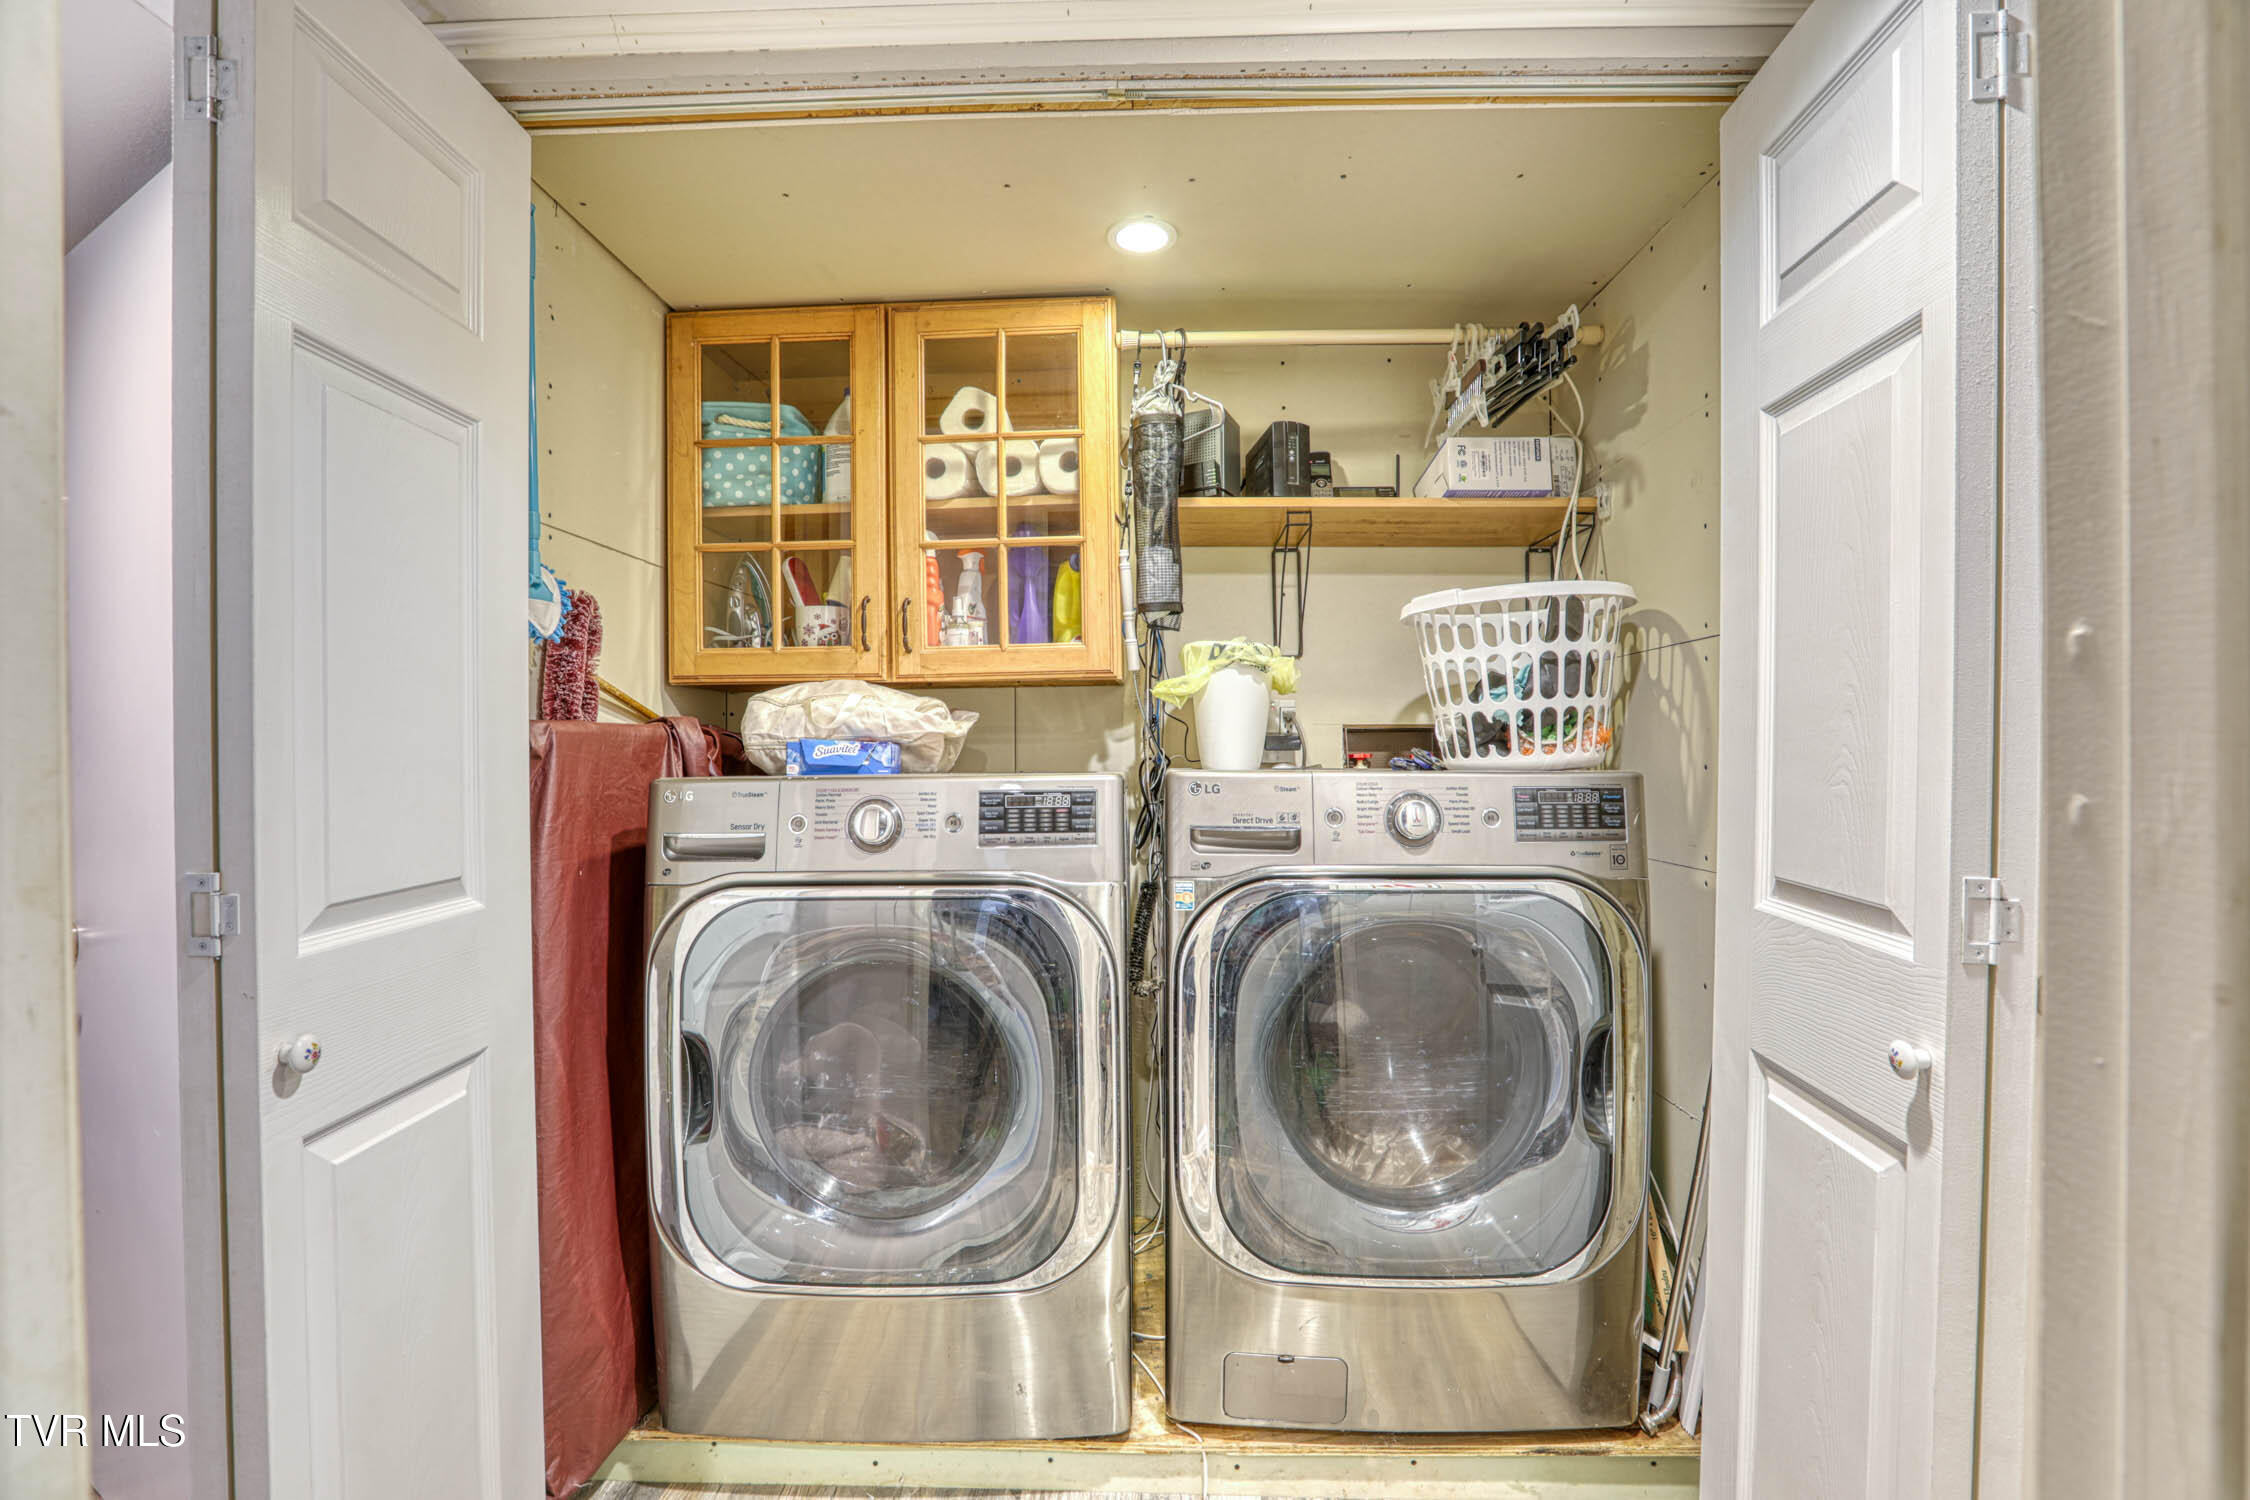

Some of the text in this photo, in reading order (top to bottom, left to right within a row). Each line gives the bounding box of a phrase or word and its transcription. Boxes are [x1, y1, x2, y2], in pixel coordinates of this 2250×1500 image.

[814, 744, 859, 757] Suavitel
[1204, 784, 1221, 794] LG
[730, 823, 765, 831] Sensor Dry
